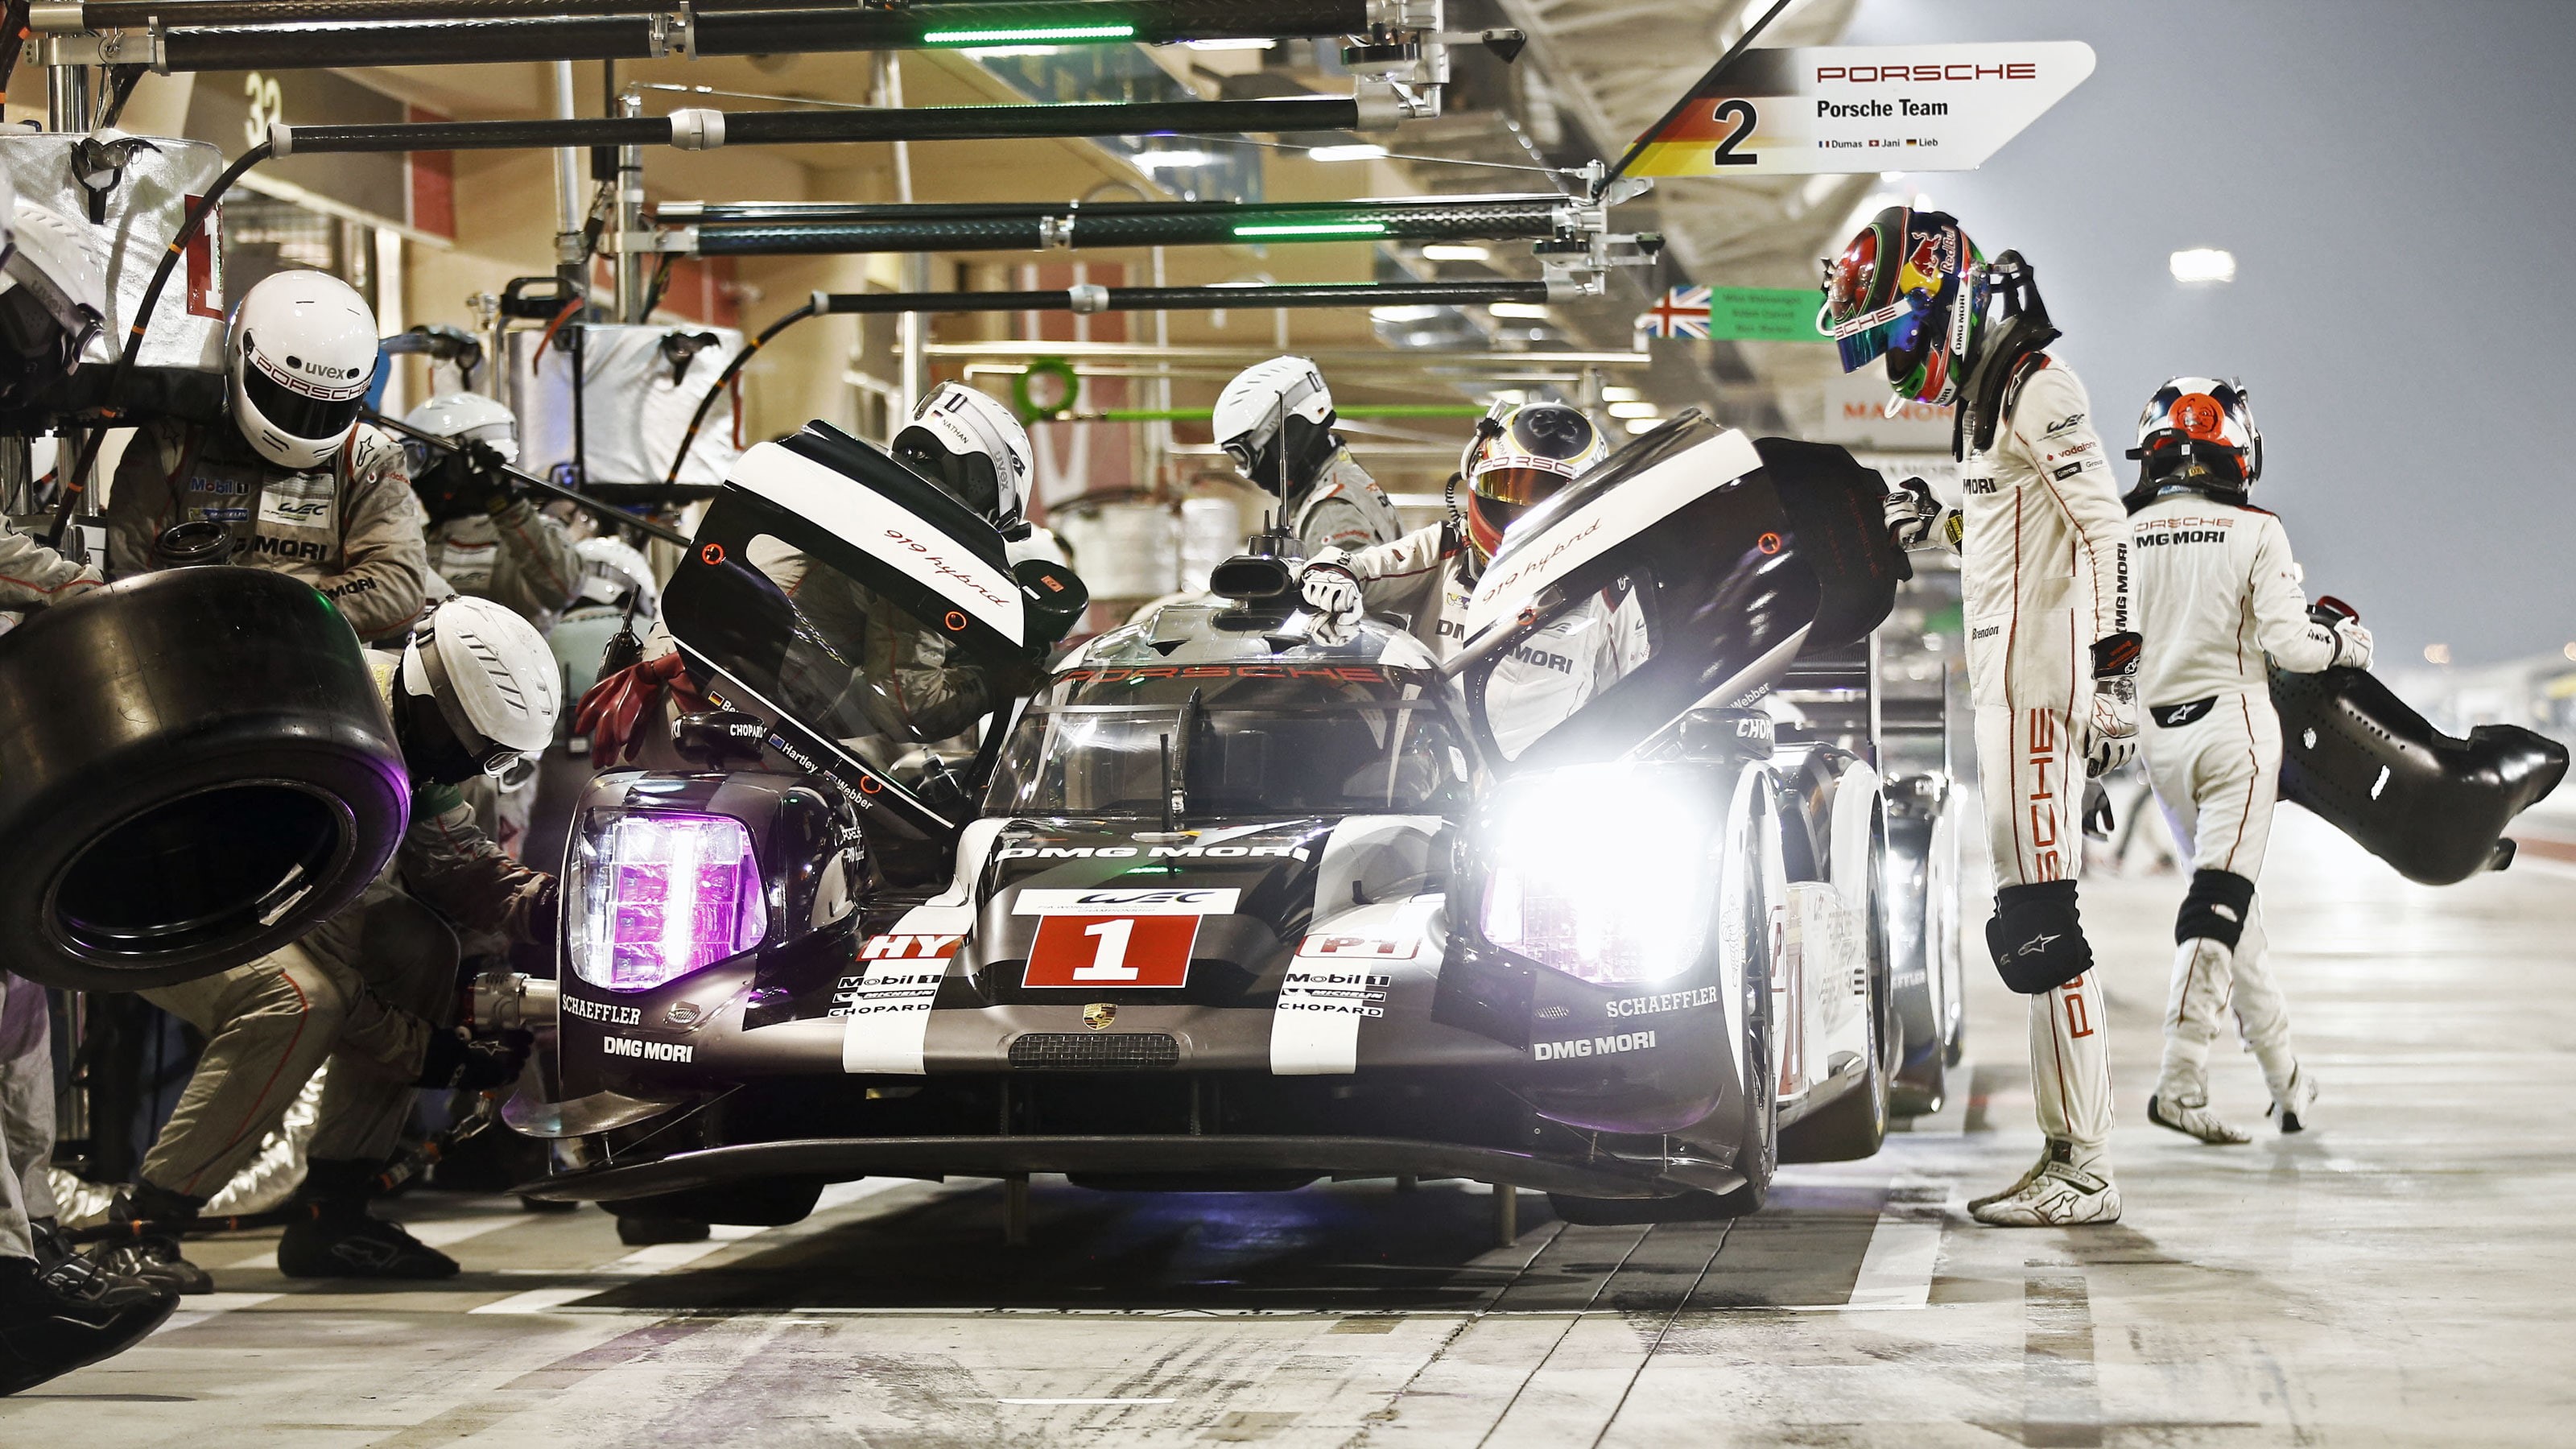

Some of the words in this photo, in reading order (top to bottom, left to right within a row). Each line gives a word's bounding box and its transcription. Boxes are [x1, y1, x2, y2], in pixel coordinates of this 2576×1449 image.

[1817, 63, 2036, 83] PORSCHE
[1818, 99, 1893, 118] Porsche
[1899, 98, 1948, 117] Team
[1714, 99, 1757, 165] 2
[1831, 139, 1863, 149] Dumas
[1881, 138, 1900, 148] Jani
[1919, 138, 1938, 147] Lieb
[1835, 306, 1897, 338] SCHE
[1955, 325, 1964, 350] DMG
[256, 356, 371, 400] PORSCHE
[305, 362, 345, 380] uvex
[1938, 388, 1952, 405] ORI
[942, 419, 969, 444] NATHAN
[2058, 441, 2097, 458] vodafone
[993, 451, 1009, 491] uvex
[1479, 456, 1574, 477] PORSC
[191, 477, 233, 494] Mobil
[2134, 517, 2235, 532] ORSCHE
[254, 535, 328, 561] MORI
[2136, 533, 2169, 550] MG
[2173, 531, 2226, 545] MORI
[884, 530, 927, 553] 919
[925, 556, 1010, 608] hybrid
[1482, 572, 1518, 605] 919
[1523, 518, 1603, 576] hybrid
[2116, 543, 2128, 593] MORI
[2115, 596, 2128, 634] MG
[1435, 619, 1464, 641] DM
[1972, 625, 2000, 640] Brendon
[1057, 666, 1385, 683] PORSCHE
[1730, 683, 1770, 708] Webber
[729, 724, 763, 738] CHOPARD
[1736, 718, 1774, 741] CHOP
[782, 742, 819, 773] Hartley
[837, 778, 873, 811] Webber
[995, 847, 1138, 861] DMG
[1148, 845, 1311, 862] MORI
[1076, 891, 1216, 904] WEC
[861, 935, 963, 959] HY
[1072, 919, 1138, 981] 1
[1320, 937, 1398, 954] P1
[839, 974, 914, 989] Mobil
[1286, 973, 1361, 985] Mobil
[863, 990, 935, 999] MICHELIN
[1311, 989, 1384, 1000] MICHELIN
[1606, 985, 1718, 1018] SCHAEFFLER
[562, 993, 642, 1026] SCHAEFFLER
[829, 1003, 931, 1017] CHOPARD
[1278, 1003, 1381, 1016] CHOPARD
[604, 1036, 642, 1058] DMG
[644, 1041, 694, 1063] MORI
[1534, 1039, 1591, 1061] DMG
[1595, 1030, 1656, 1055] MORI
